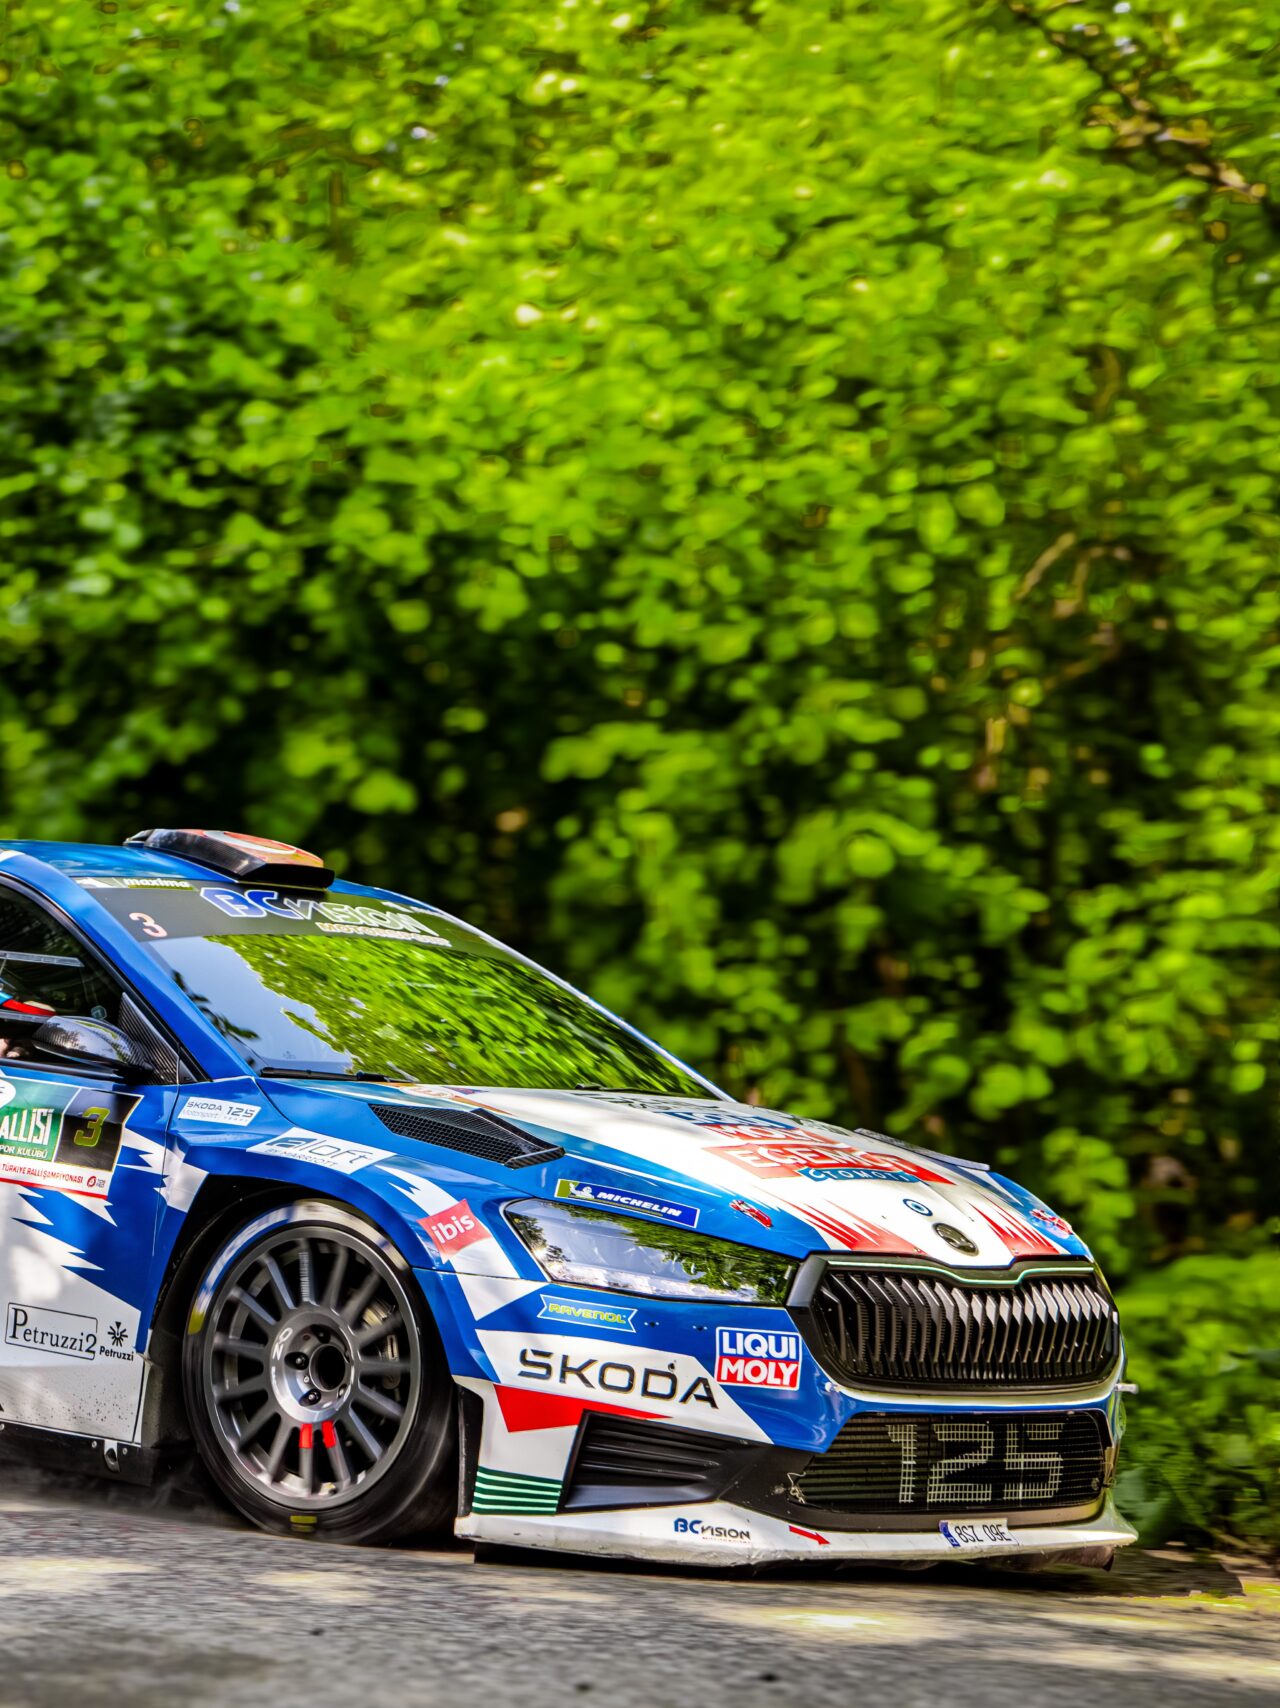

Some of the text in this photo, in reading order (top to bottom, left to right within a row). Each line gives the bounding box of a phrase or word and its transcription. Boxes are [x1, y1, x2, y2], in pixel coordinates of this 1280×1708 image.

[128, 912, 168, 938] 3
[73, 1106, 111, 1148] 3
[266, 1137, 374, 1164] aloft
[596, 1191, 683, 1217] MICHELIN
[430, 1211, 476, 1245] ibis
[99, 1345, 134, 1361] Petruzzi
[722, 1331, 796, 1360] LIQUI
[721, 1358, 798, 1388] MOLY
[886, 1423, 1065, 1503] 125
